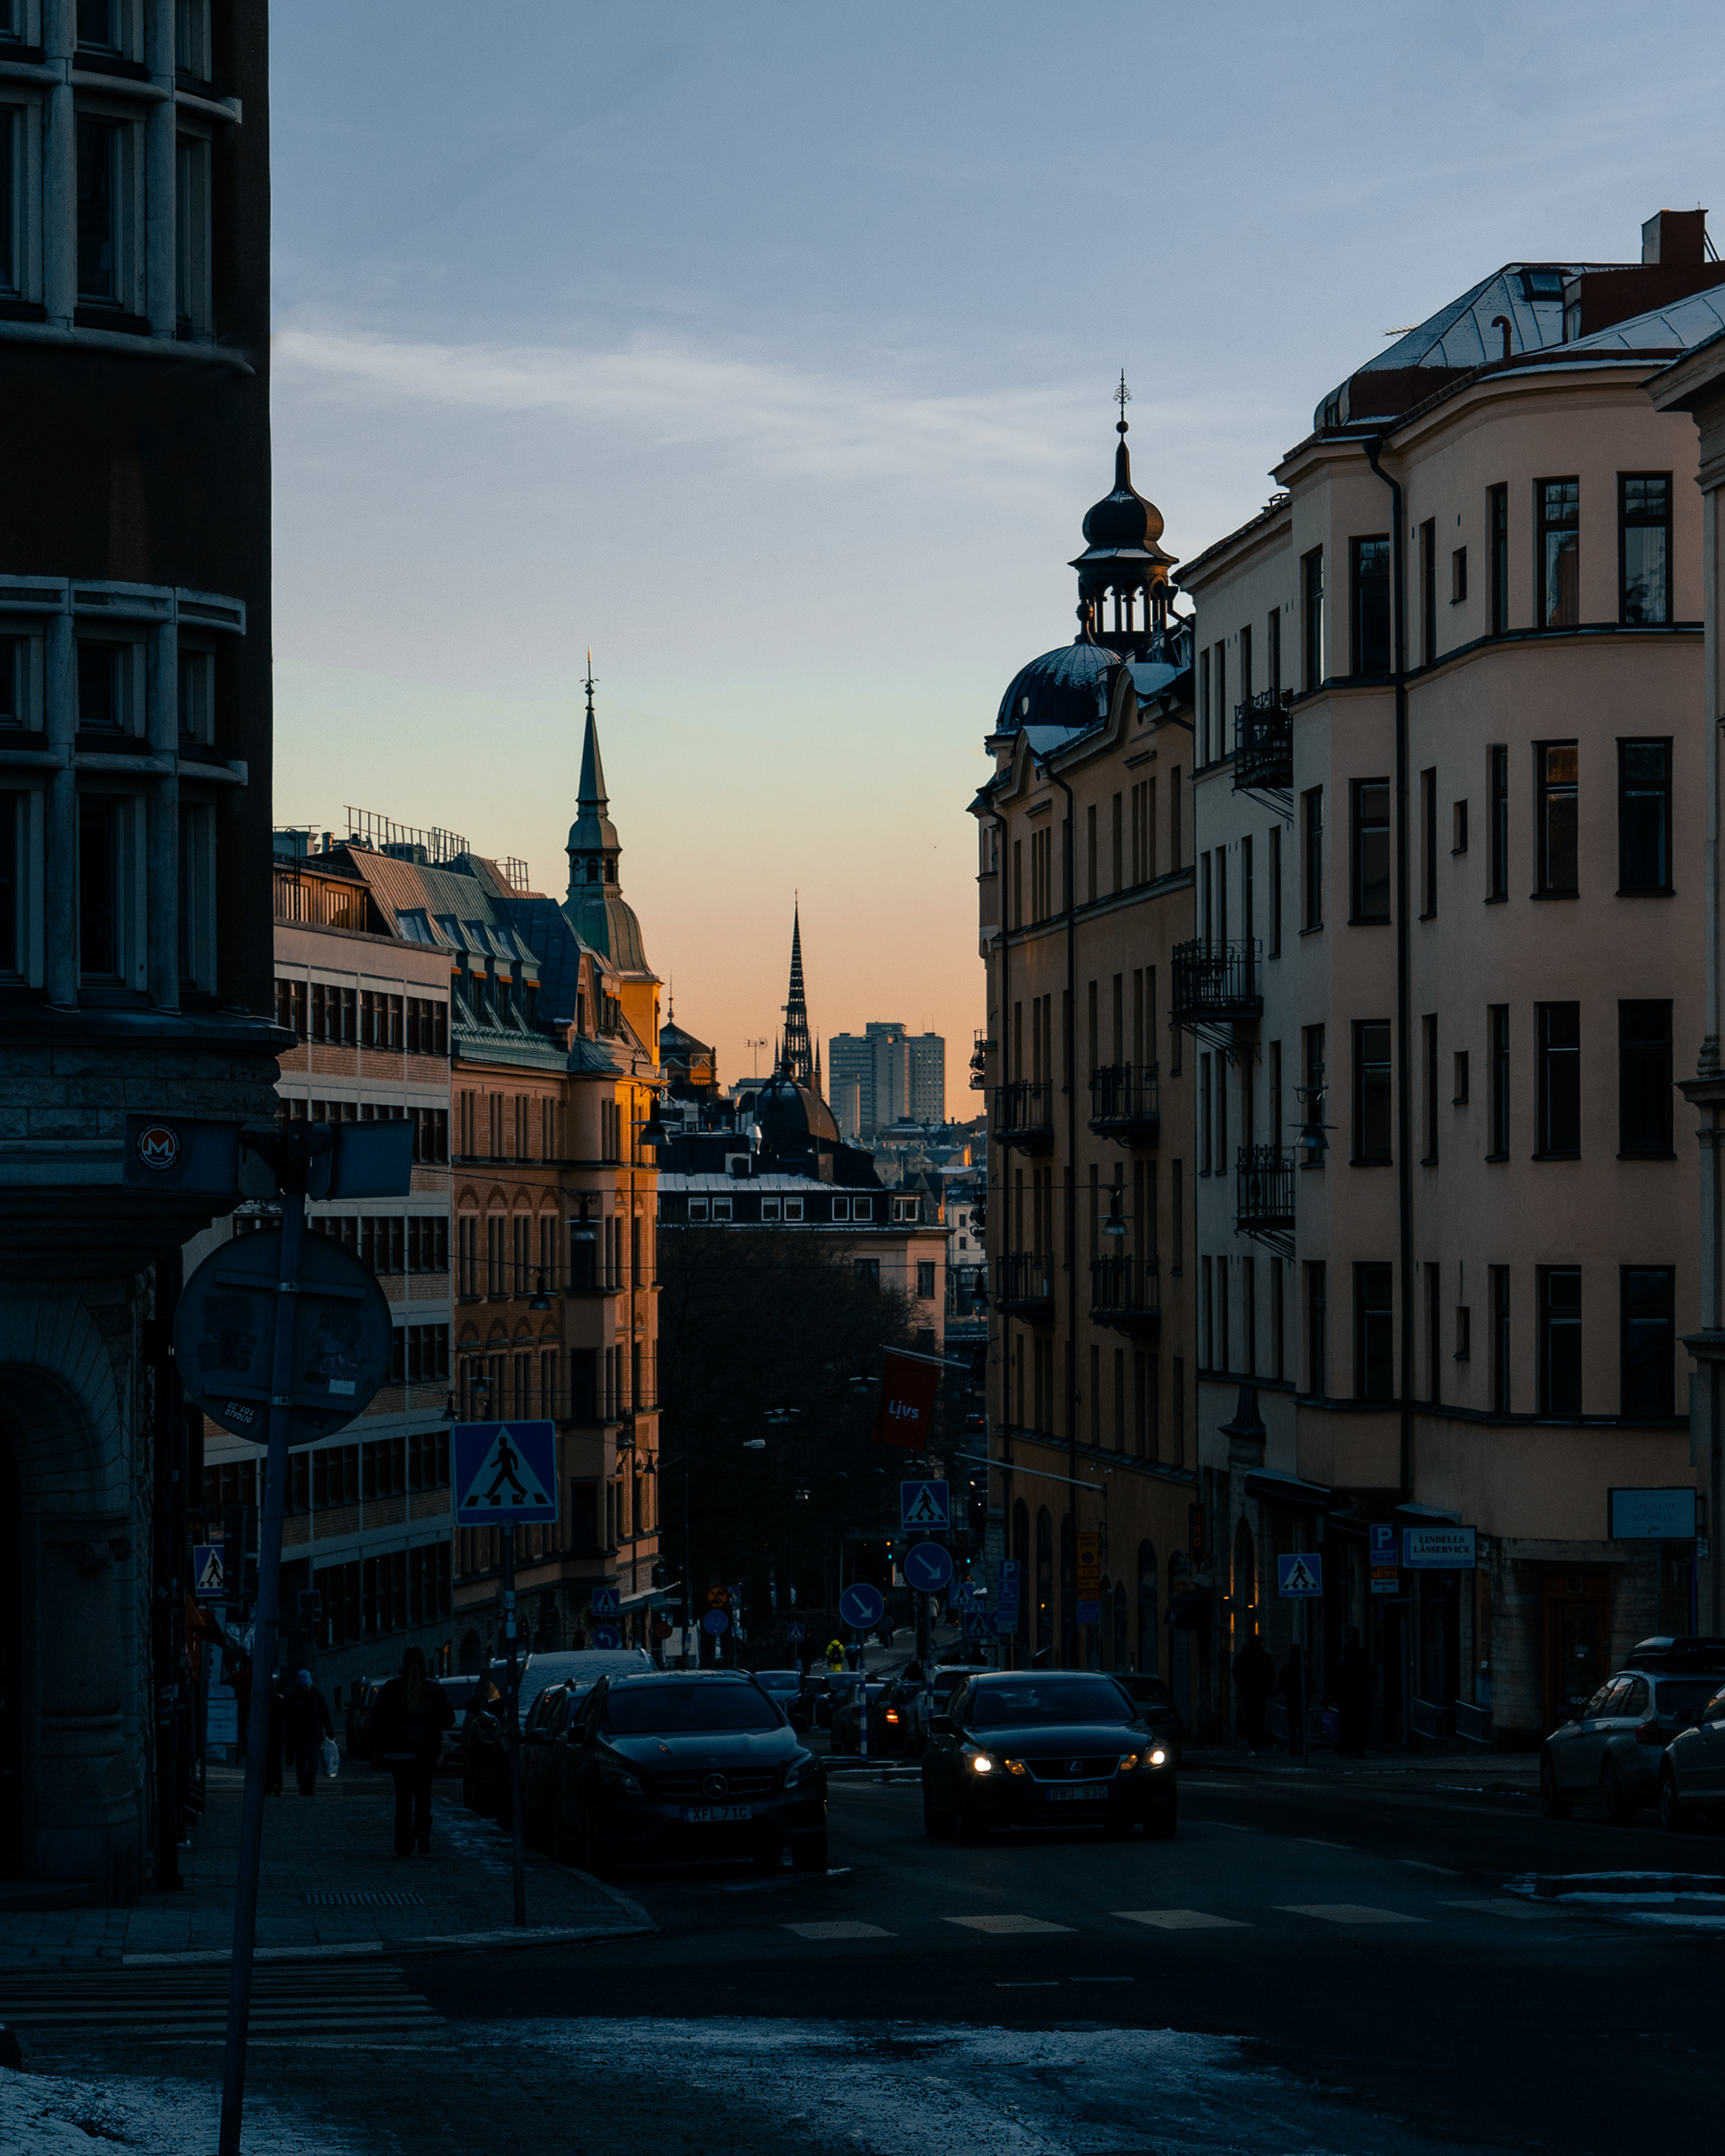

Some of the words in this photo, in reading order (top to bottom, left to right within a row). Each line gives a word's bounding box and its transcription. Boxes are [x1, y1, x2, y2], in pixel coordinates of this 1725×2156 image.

[227, 1401, 255, 1416] 101.38
[889, 1400, 920, 1420] Livs
[1193, 1513, 1201, 1547] BBQ
[1377, 1527, 1393, 1549] P
[1419, 1535, 1464, 1543] LINDELLS
[1413, 1544, 1471, 1553] LÅSSERVICE
[1004, 1562, 1015, 1578] P
[1052, 1788, 1075, 1798] BBU
[1082, 1787, 1106, 1798] 930
[693, 1807, 718, 1820] XFL
[721, 1806, 747, 1819] 71C
